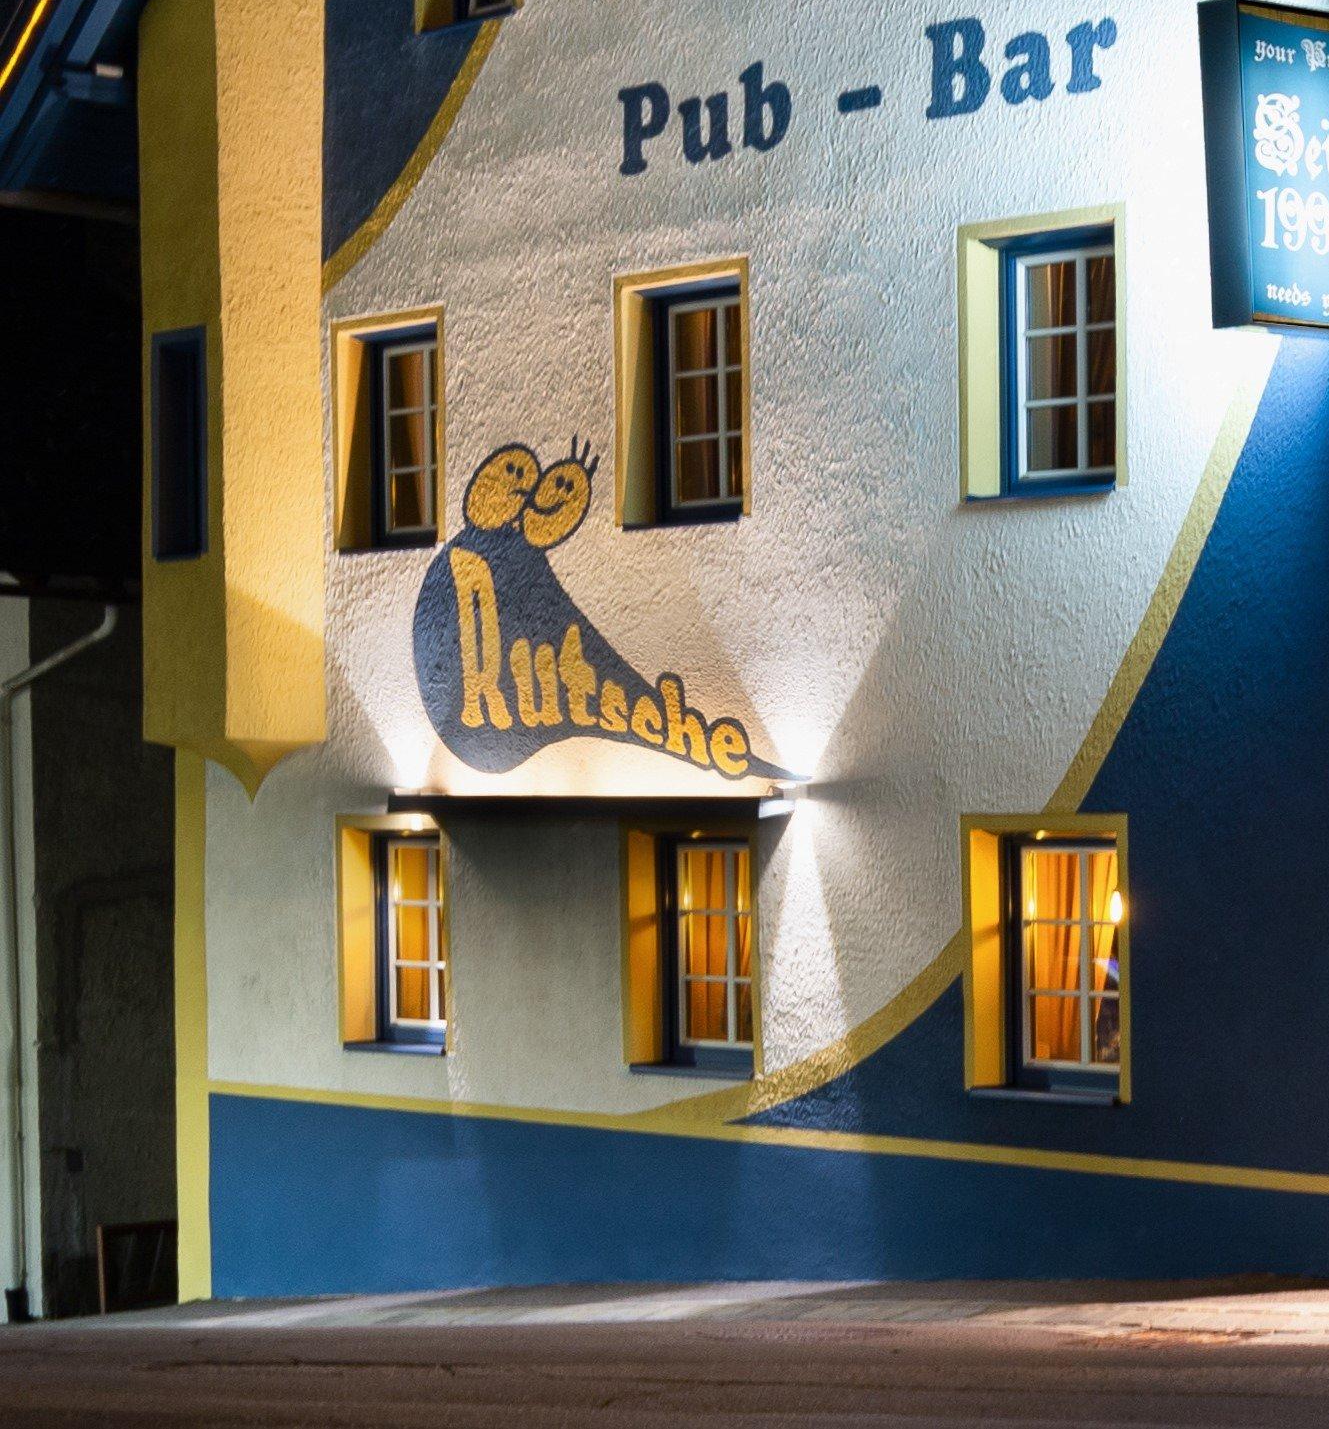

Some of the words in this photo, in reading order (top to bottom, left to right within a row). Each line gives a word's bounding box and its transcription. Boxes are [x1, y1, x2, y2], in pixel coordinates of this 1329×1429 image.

[618, 61, 792, 176] Pub
[926, 17, 1118, 120] Bar
[1254, 39, 1296, 66] your
[1266, 281, 1311, 308] needs
[450, 547, 748, 775] Rutsche
